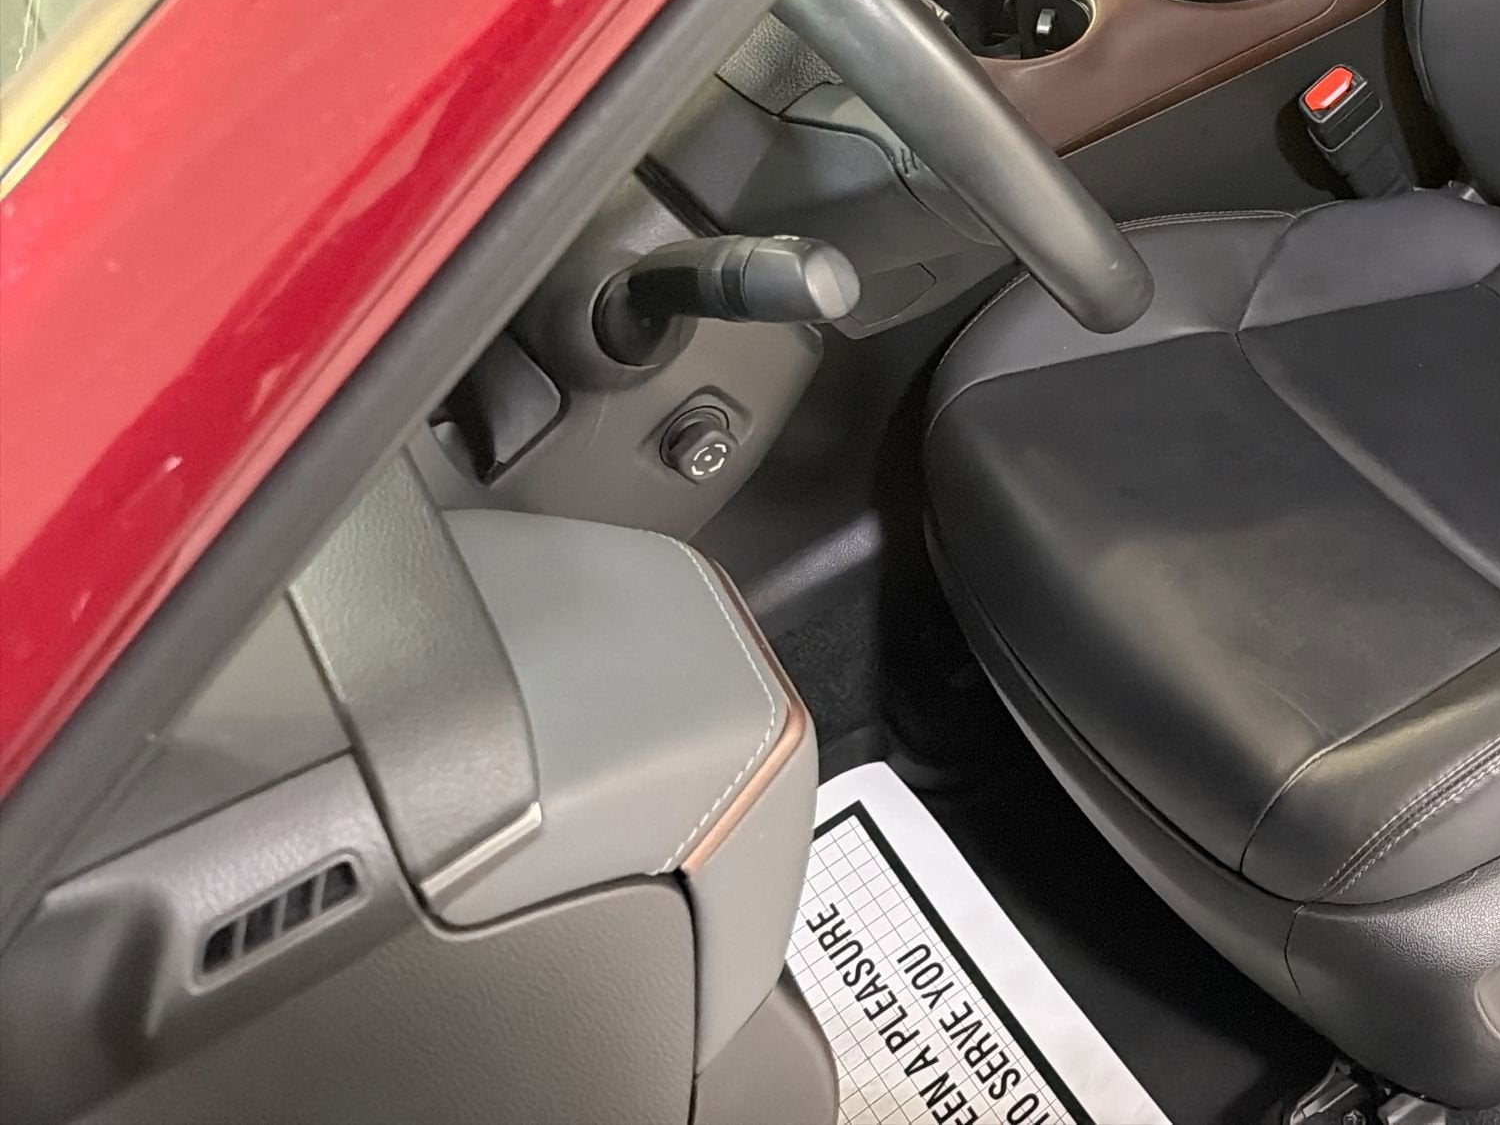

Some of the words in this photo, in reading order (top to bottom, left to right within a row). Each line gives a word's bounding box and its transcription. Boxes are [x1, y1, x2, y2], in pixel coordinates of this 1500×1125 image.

[806, 903, 920, 1054] PLEASURE
[897, 944, 954, 1009] YOU
[904, 1044, 939, 1077] A
[939, 1000, 1021, 1100] SERVE
